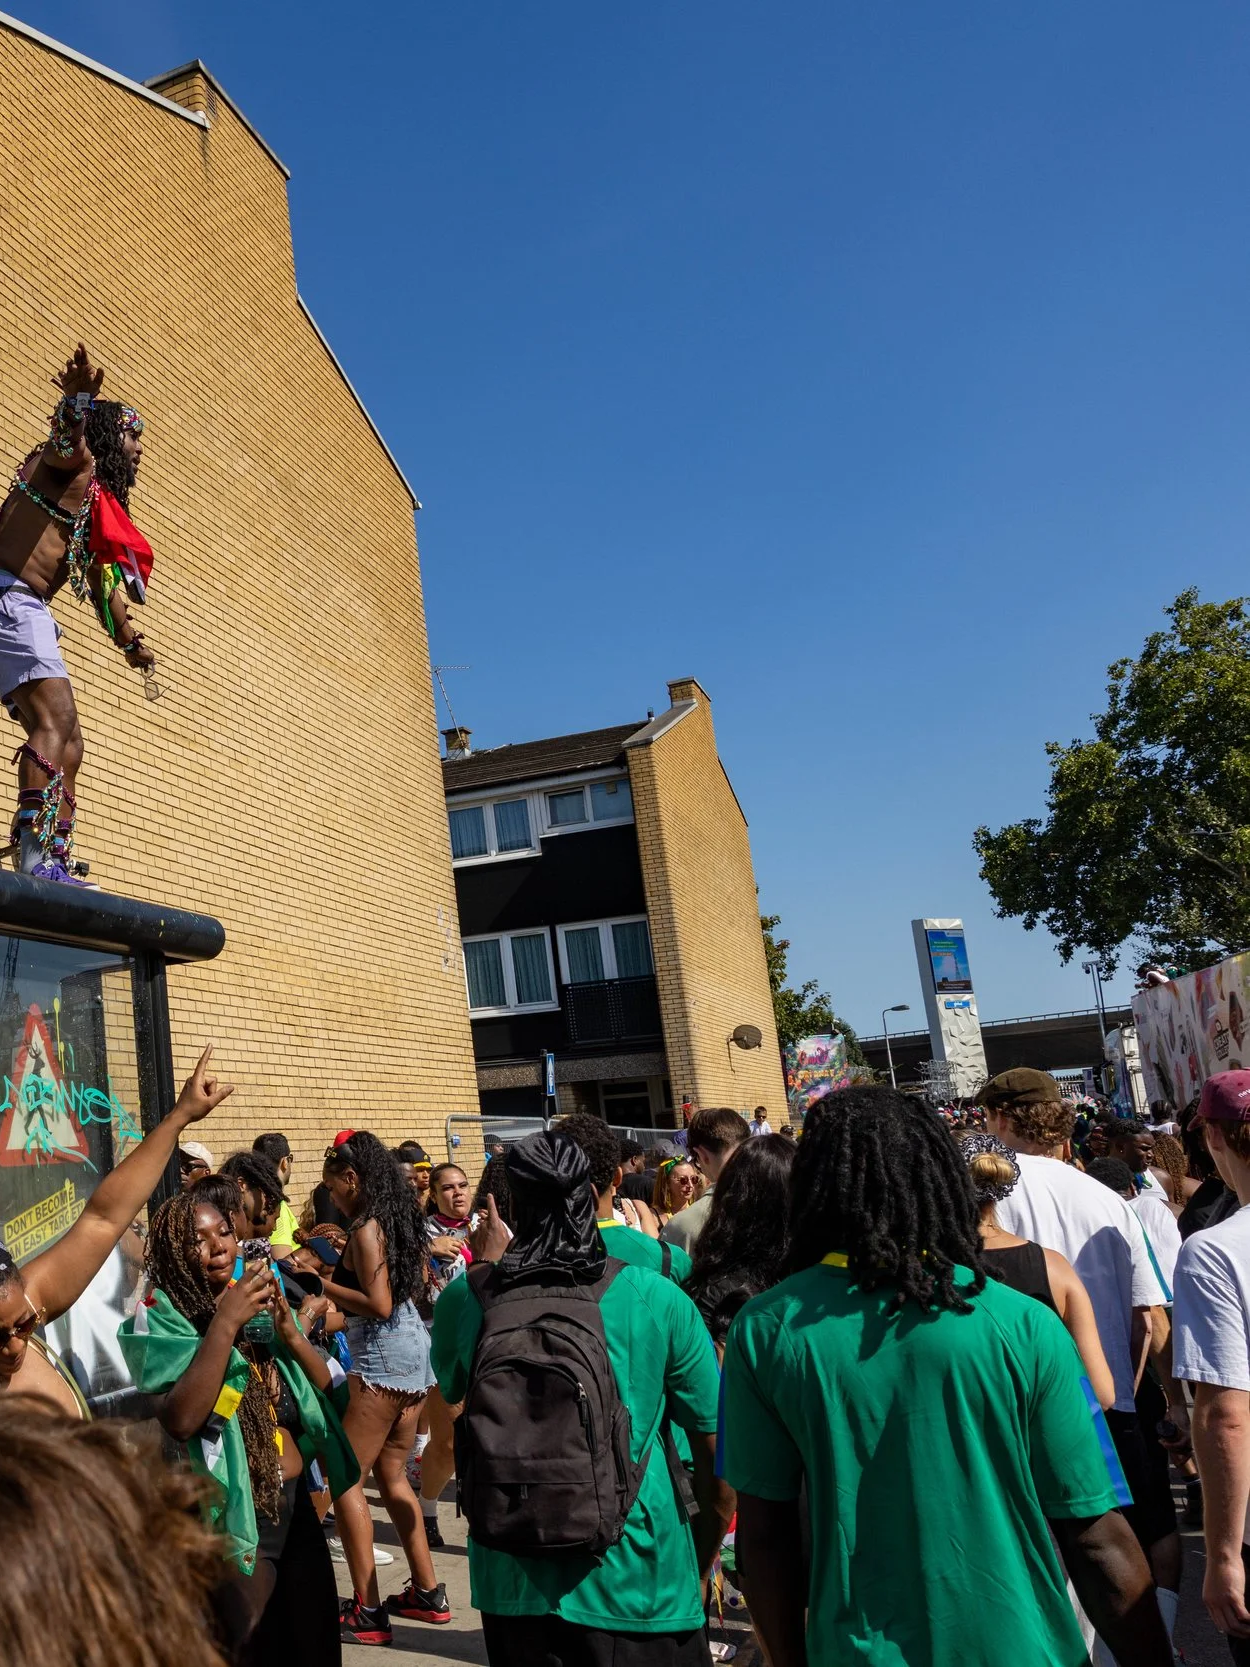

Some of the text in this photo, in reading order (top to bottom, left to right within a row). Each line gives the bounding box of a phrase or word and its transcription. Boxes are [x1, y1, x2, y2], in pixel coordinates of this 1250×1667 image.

[6, 1186, 74, 1240] DON'T BECOME
[10, 1243, 22, 1261] AN
[23, 1226, 48, 1252] EASY
